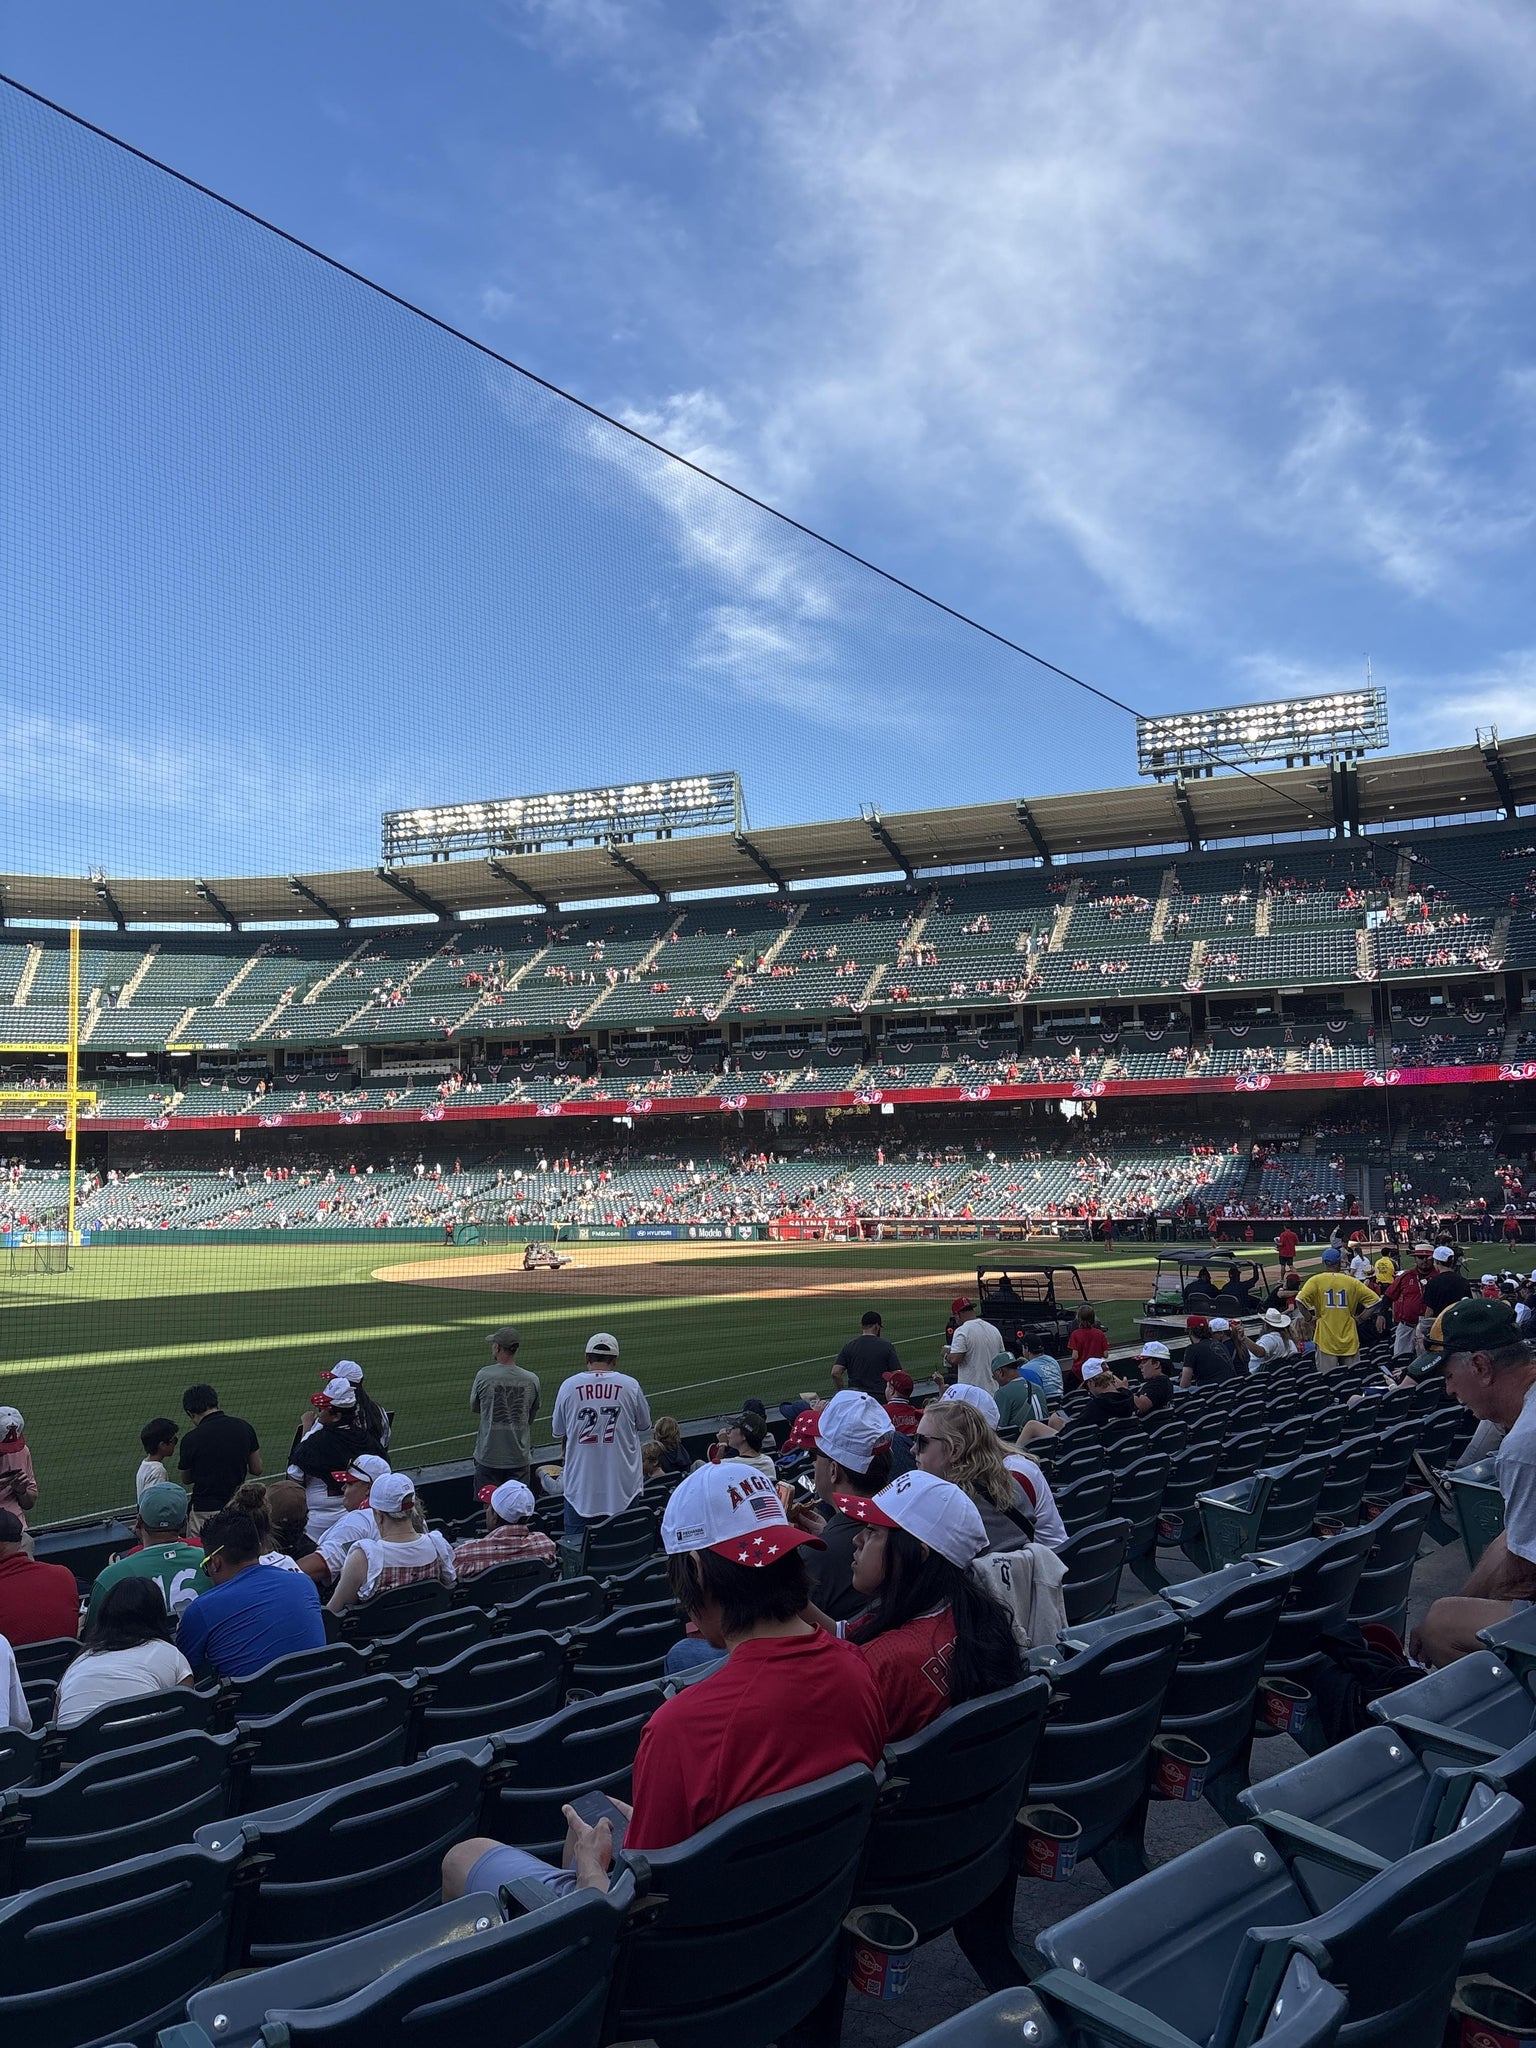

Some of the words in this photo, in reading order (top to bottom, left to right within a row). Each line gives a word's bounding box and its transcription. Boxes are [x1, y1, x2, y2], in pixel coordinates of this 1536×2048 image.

[698, 1227, 722, 1238] Modelo
[1324, 1288, 1348, 1308] 11
[1421, 1355, 1442, 1371] OAKLAND
[576, 1383, 623, 1401] TROUT
[578, 1406, 621, 1444] 27
